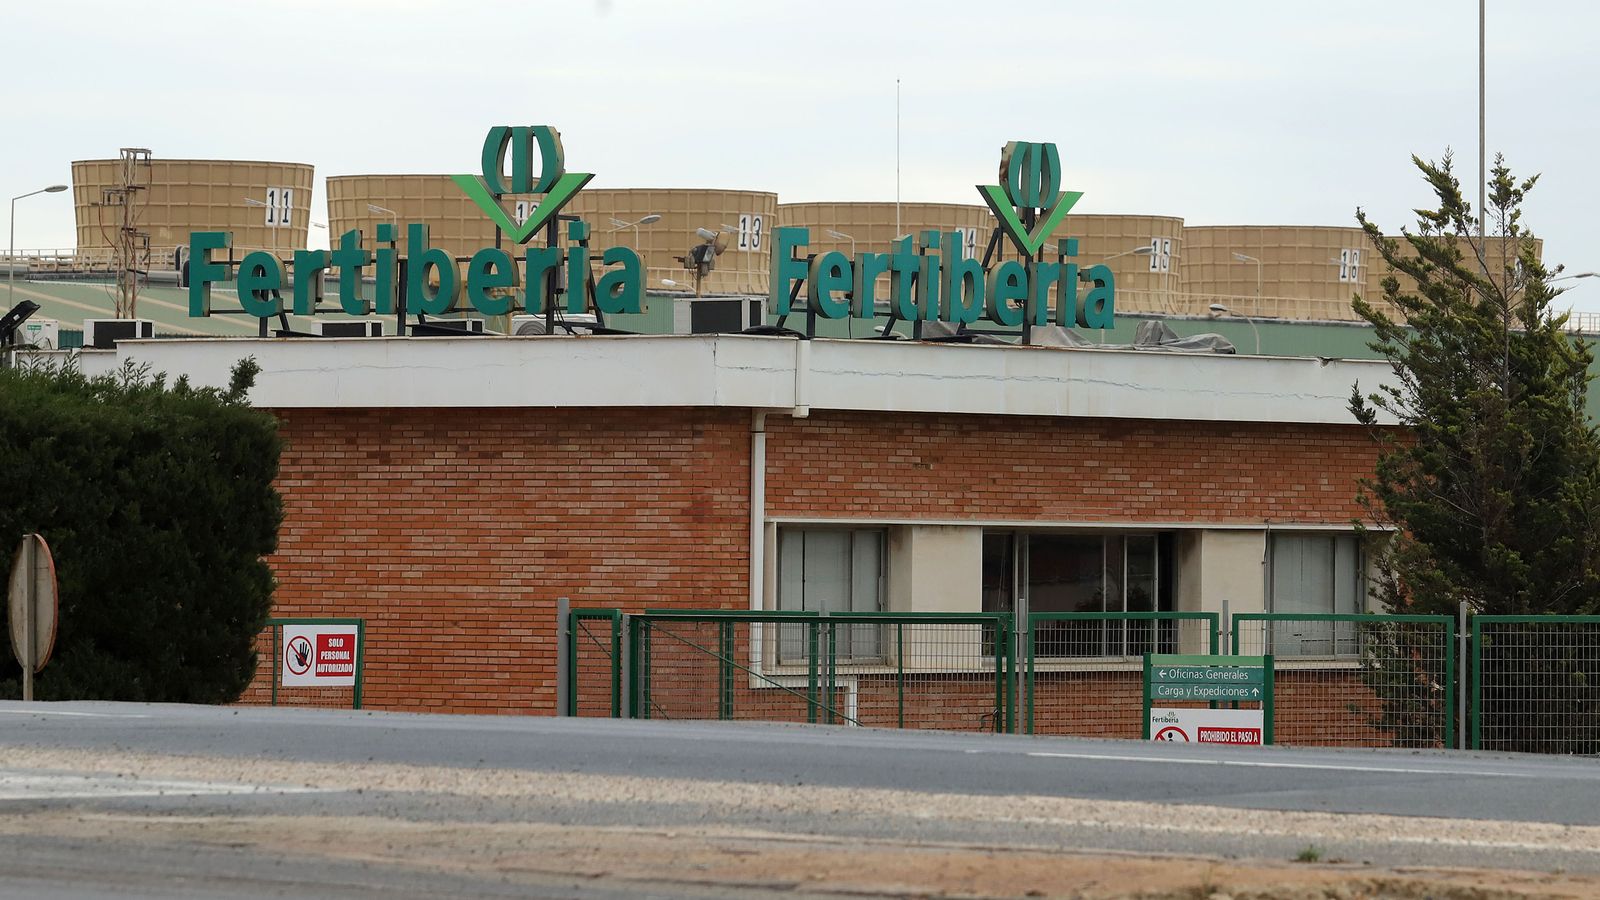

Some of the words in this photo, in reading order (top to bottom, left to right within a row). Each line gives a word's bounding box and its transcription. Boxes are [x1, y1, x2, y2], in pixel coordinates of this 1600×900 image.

[267, 190, 289, 223] 11
[741, 216, 761, 248] 13
[1151, 240, 1170, 269] 15
[189, 223, 648, 317] Fertiberia
[770, 227, 1115, 330] Fertiberia
[328, 638, 343, 647] SOLO
[320, 650, 350, 660] PERSONAL
[316, 663, 353, 673] AUTORIZADO
[1168, 668, 1204, 679] Oficinas
[1205, 669, 1249, 680] Generales
[1158, 685, 1184, 698] Carga
[1186, 688, 1192, 698] y
[1193, 685, 1249, 698] Expediciones
[1200, 730, 1230, 743] PROHIBIDO
[1230, 731, 1238, 743] EL
[1238, 731, 1253, 743] PASO
[1253, 731, 1259, 743] A
